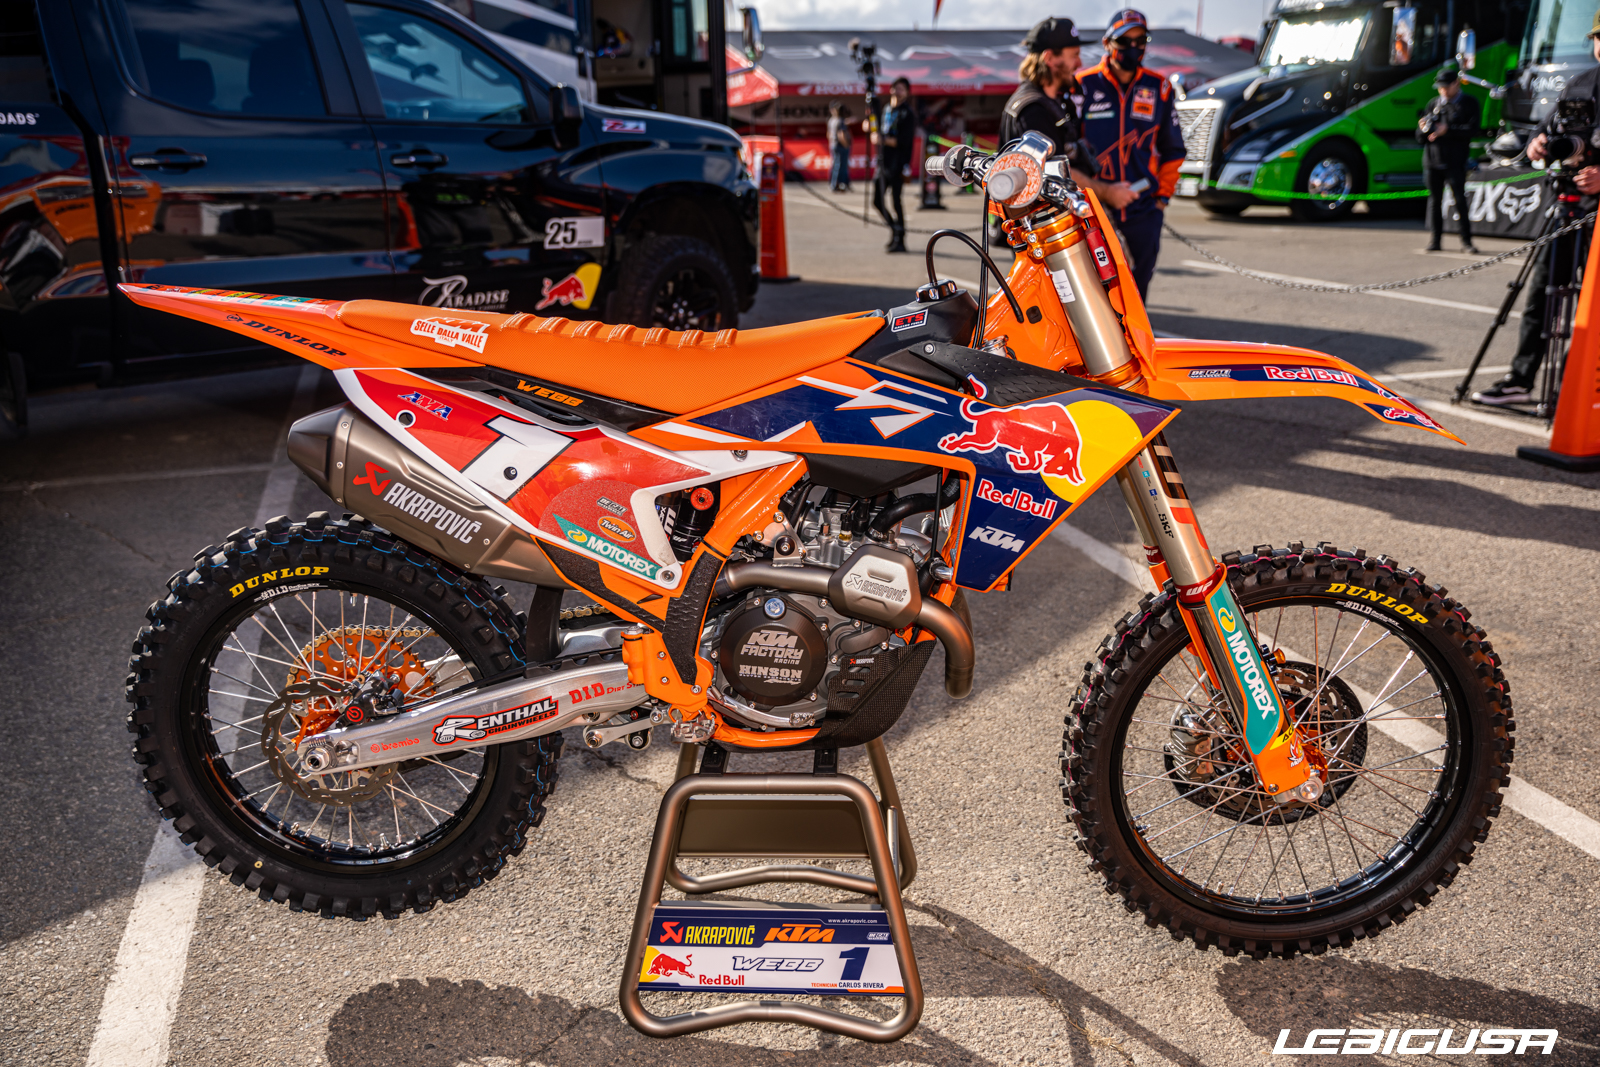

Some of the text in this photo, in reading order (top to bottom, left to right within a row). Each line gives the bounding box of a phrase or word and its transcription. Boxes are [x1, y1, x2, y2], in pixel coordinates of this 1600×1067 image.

[548, 221, 578, 246] 25
[895, 312, 925, 327] ETS
[243, 320, 348, 357] DUNLOP
[414, 320, 484, 348] SELLE DALLA VALLE
[1263, 366, 1360, 387] Red Bull
[397, 391, 453, 421] AMA
[516, 379, 584, 407] WEBB
[459, 413, 579, 503] 1
[976, 478, 1058, 520] Red Bull
[383, 482, 482, 544] AKRAPOVIČ
[1158, 513, 1174, 539] SKF
[601, 519, 636, 540] Twin Air
[968, 526, 1026, 553] KTM
[587, 536, 655, 577] MOTOREX
[229, 566, 330, 598] DUNLOP
[1325, 582, 1429, 624] DUNLOP
[747, 629, 799, 648] KTM
[740, 644, 804, 660] FACTORY
[739, 664, 803, 679] HINSON
[1227, 630, 1275, 720] MOTOREX
[568, 682, 606, 705] D.I.D
[606, 685, 626, 694] DIRT
[488, 710, 556, 735] CHAINWHEELS
[382, 737, 421, 751] brembo
[685, 925, 756, 945] AKRAPOVIČ
[764, 923, 836, 943] KTM
[732, 946, 870, 981] WEBB 1
[699, 974, 745, 986] Red Bull
